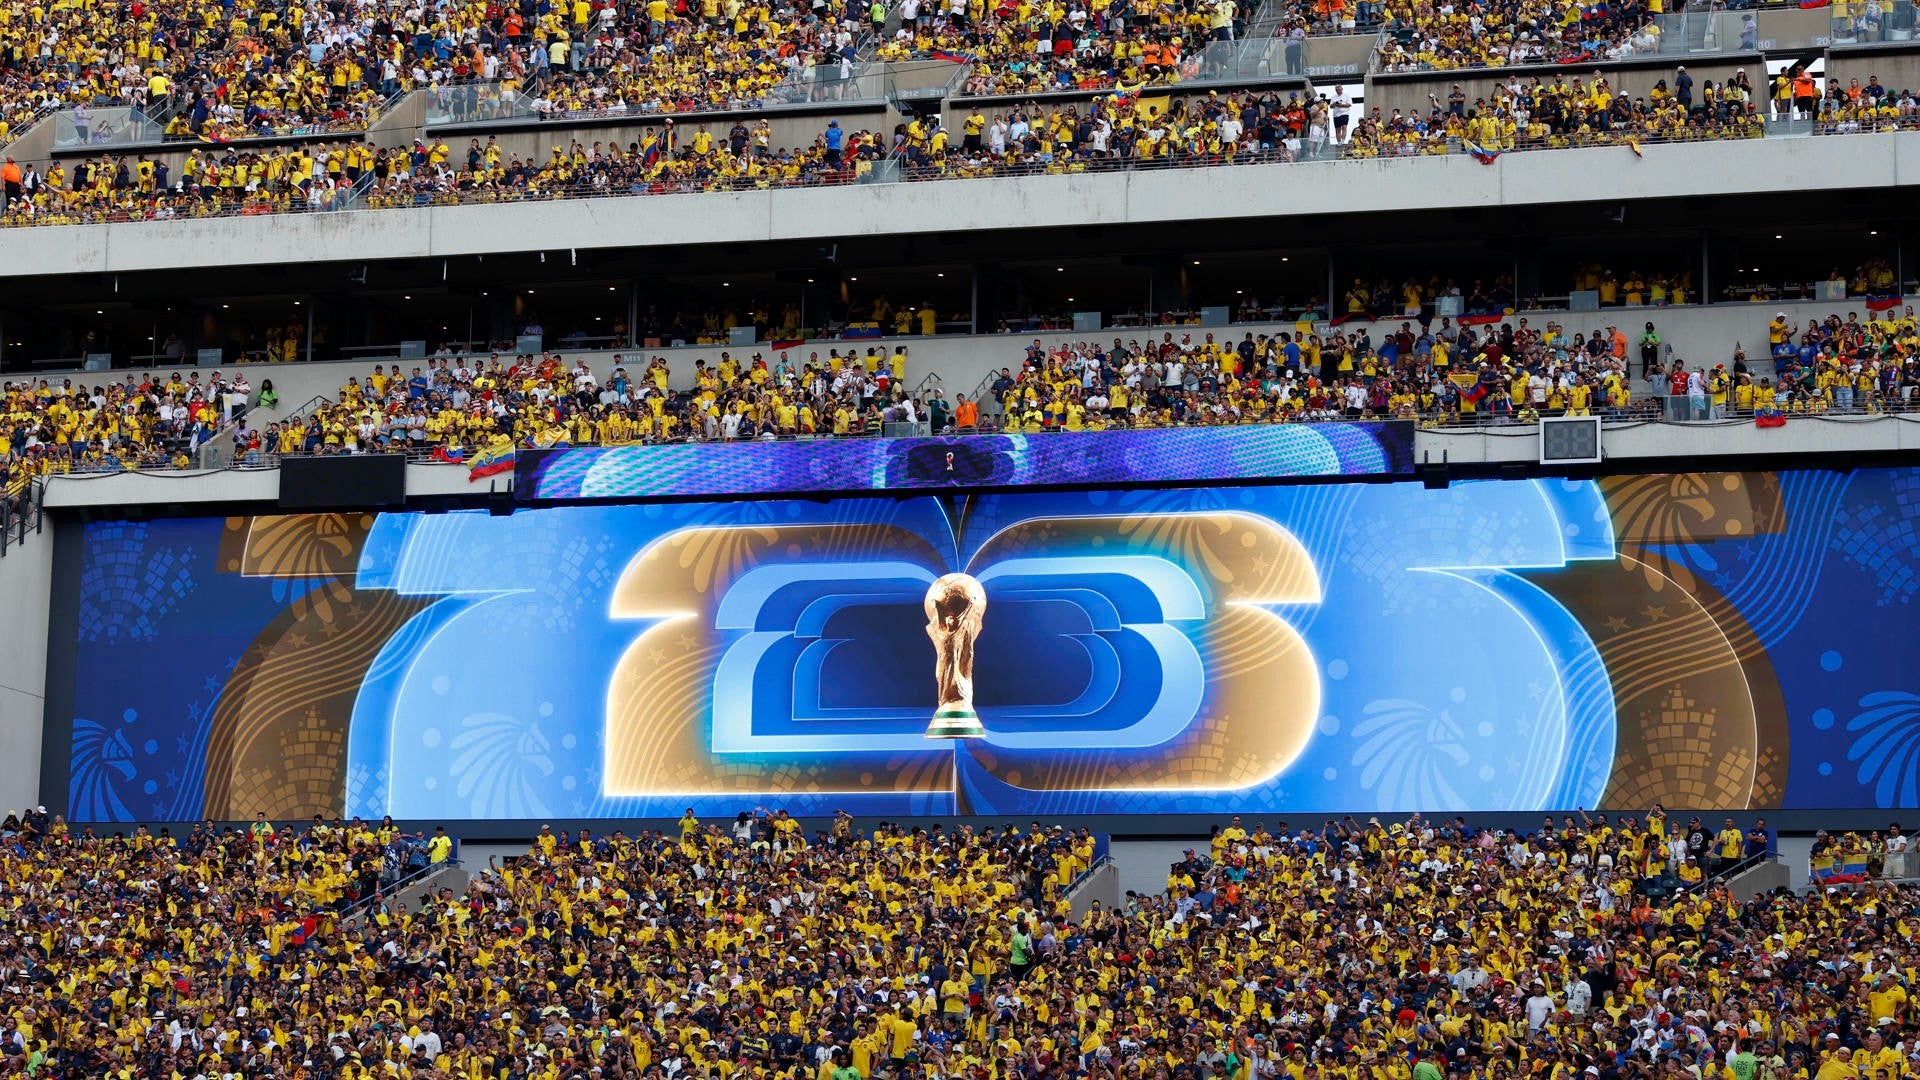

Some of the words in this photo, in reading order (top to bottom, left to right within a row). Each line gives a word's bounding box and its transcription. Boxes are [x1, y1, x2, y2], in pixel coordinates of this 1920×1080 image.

[1334, 64, 1355, 74] 210
[902, 90, 920, 98] 212
[623, 355, 641, 363] M11
